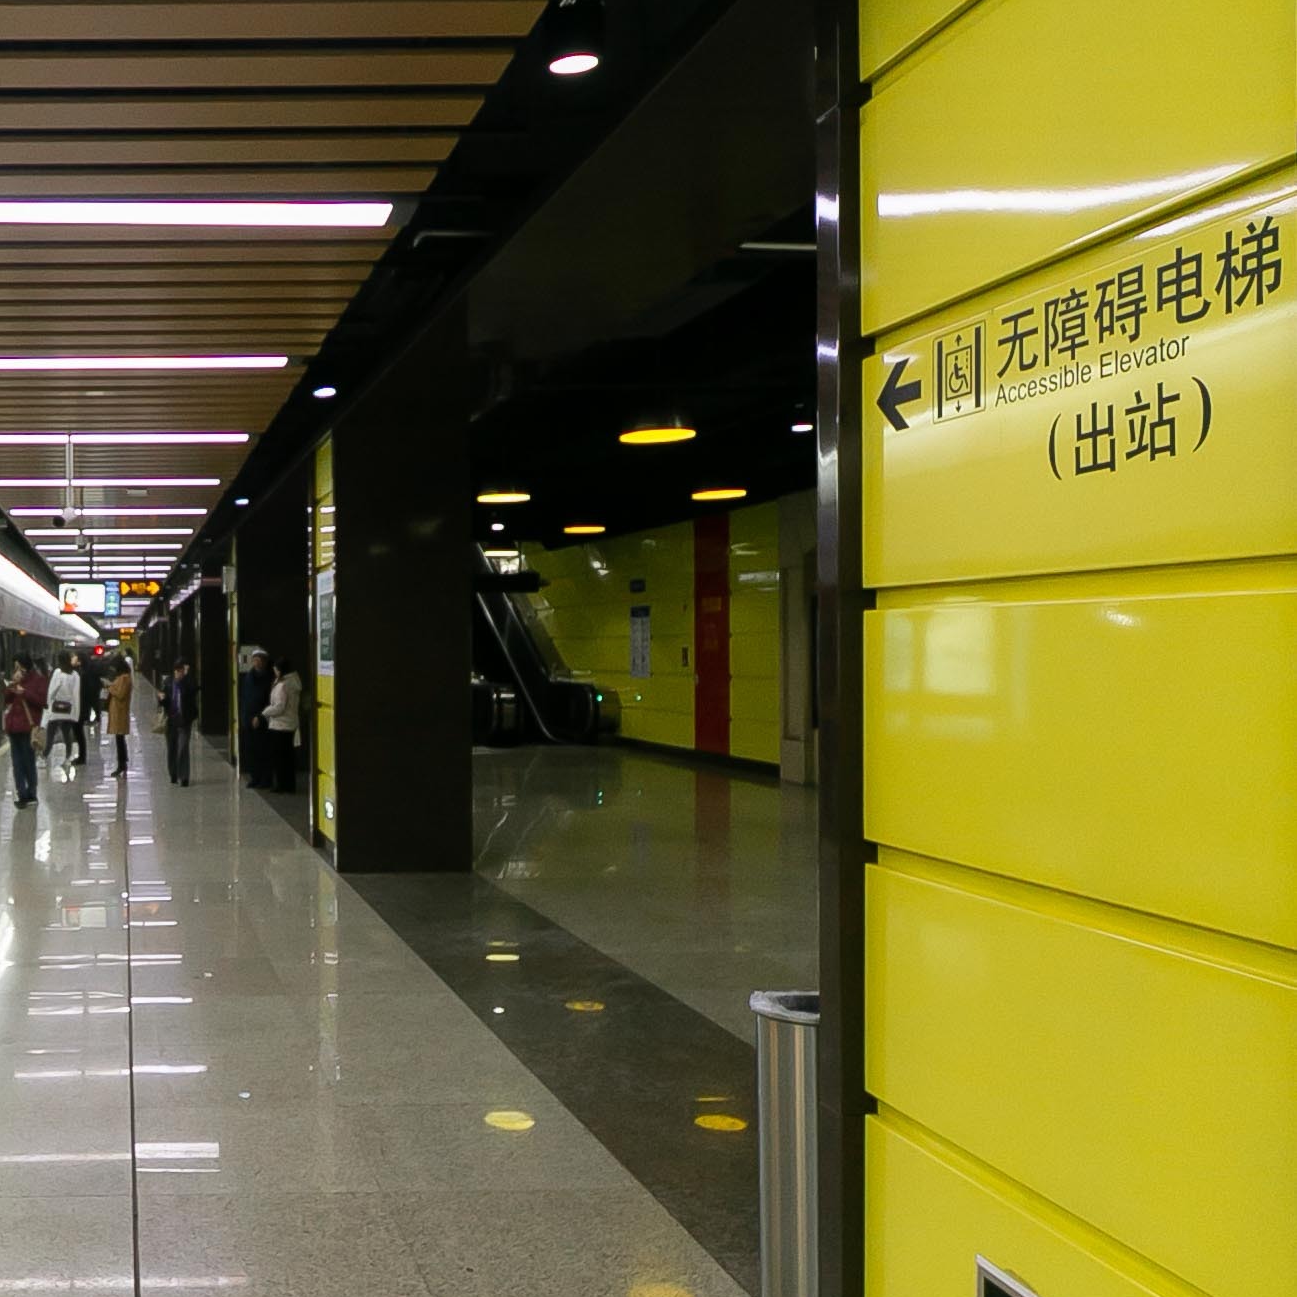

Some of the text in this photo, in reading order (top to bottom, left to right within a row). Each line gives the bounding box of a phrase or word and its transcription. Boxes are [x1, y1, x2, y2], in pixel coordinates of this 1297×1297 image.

[995, 215, 1283, 380] 无障碍电梯
[995, 335, 1190, 408] Accessible Elevator
